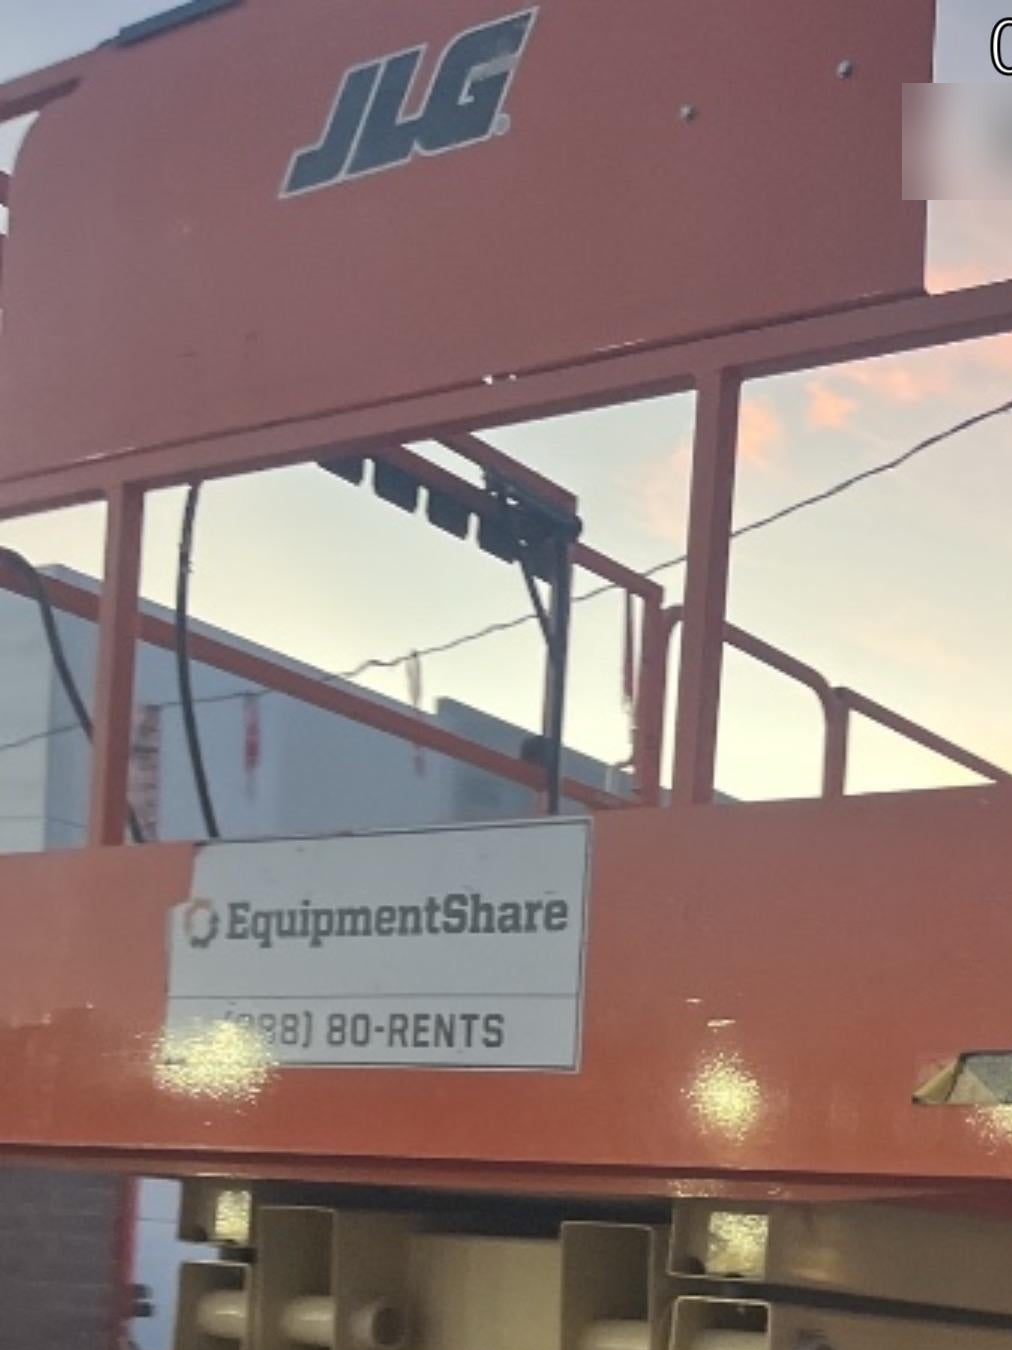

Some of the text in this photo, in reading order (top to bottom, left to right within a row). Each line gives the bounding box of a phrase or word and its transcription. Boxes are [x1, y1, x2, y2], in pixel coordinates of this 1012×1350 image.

[278, 6, 540, 199] JLG
[225, 893, 568, 948] EquipmentShare
[223, 1010, 505, 1049] 88) 80-RENTS
